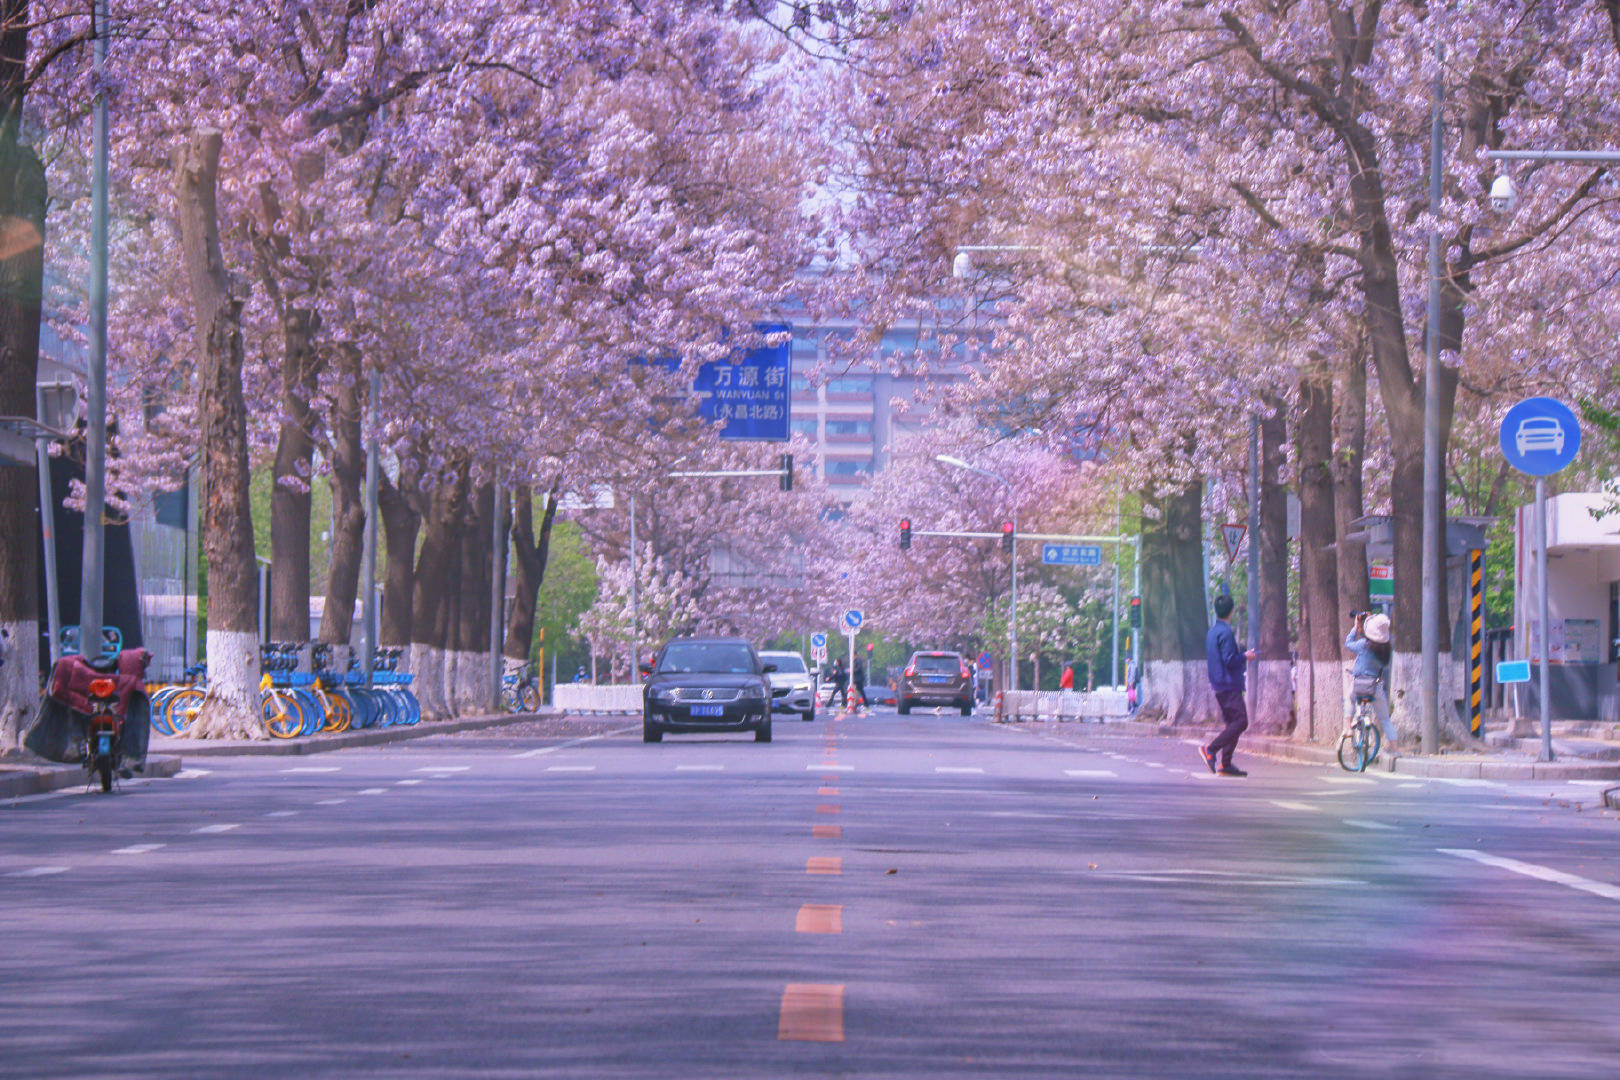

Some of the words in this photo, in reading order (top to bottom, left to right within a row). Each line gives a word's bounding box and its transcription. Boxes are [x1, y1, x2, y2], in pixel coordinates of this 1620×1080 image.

[713, 366, 786, 387] 万源街
[717, 390, 770, 400] WANYUAN
